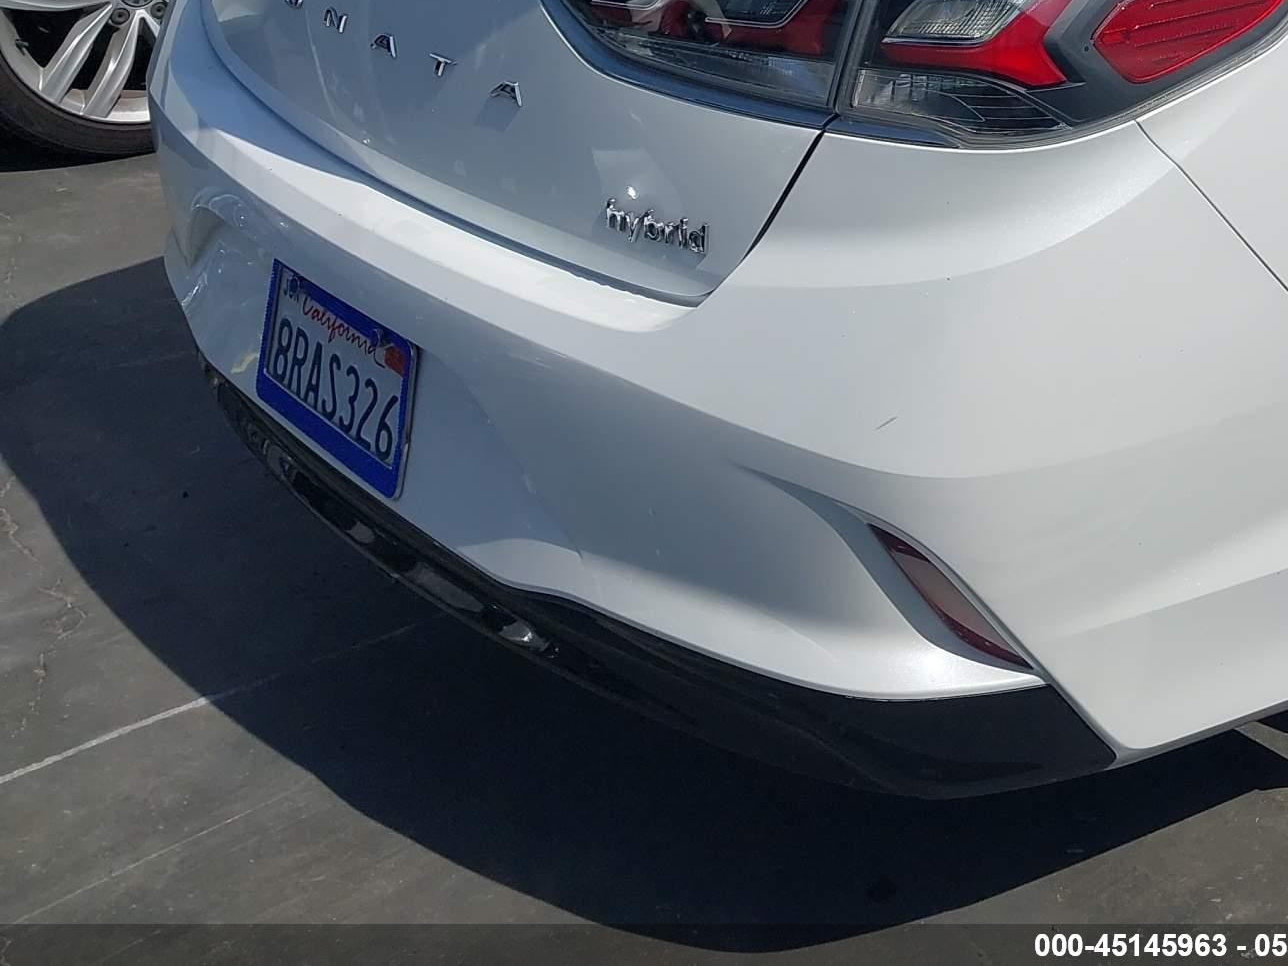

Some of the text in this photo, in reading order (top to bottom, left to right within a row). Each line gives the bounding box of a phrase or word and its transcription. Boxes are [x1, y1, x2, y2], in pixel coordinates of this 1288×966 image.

[605, 197, 711, 254] hybrid
[302, 294, 386, 369] California
[272, 317, 399, 461] 8RAS326
